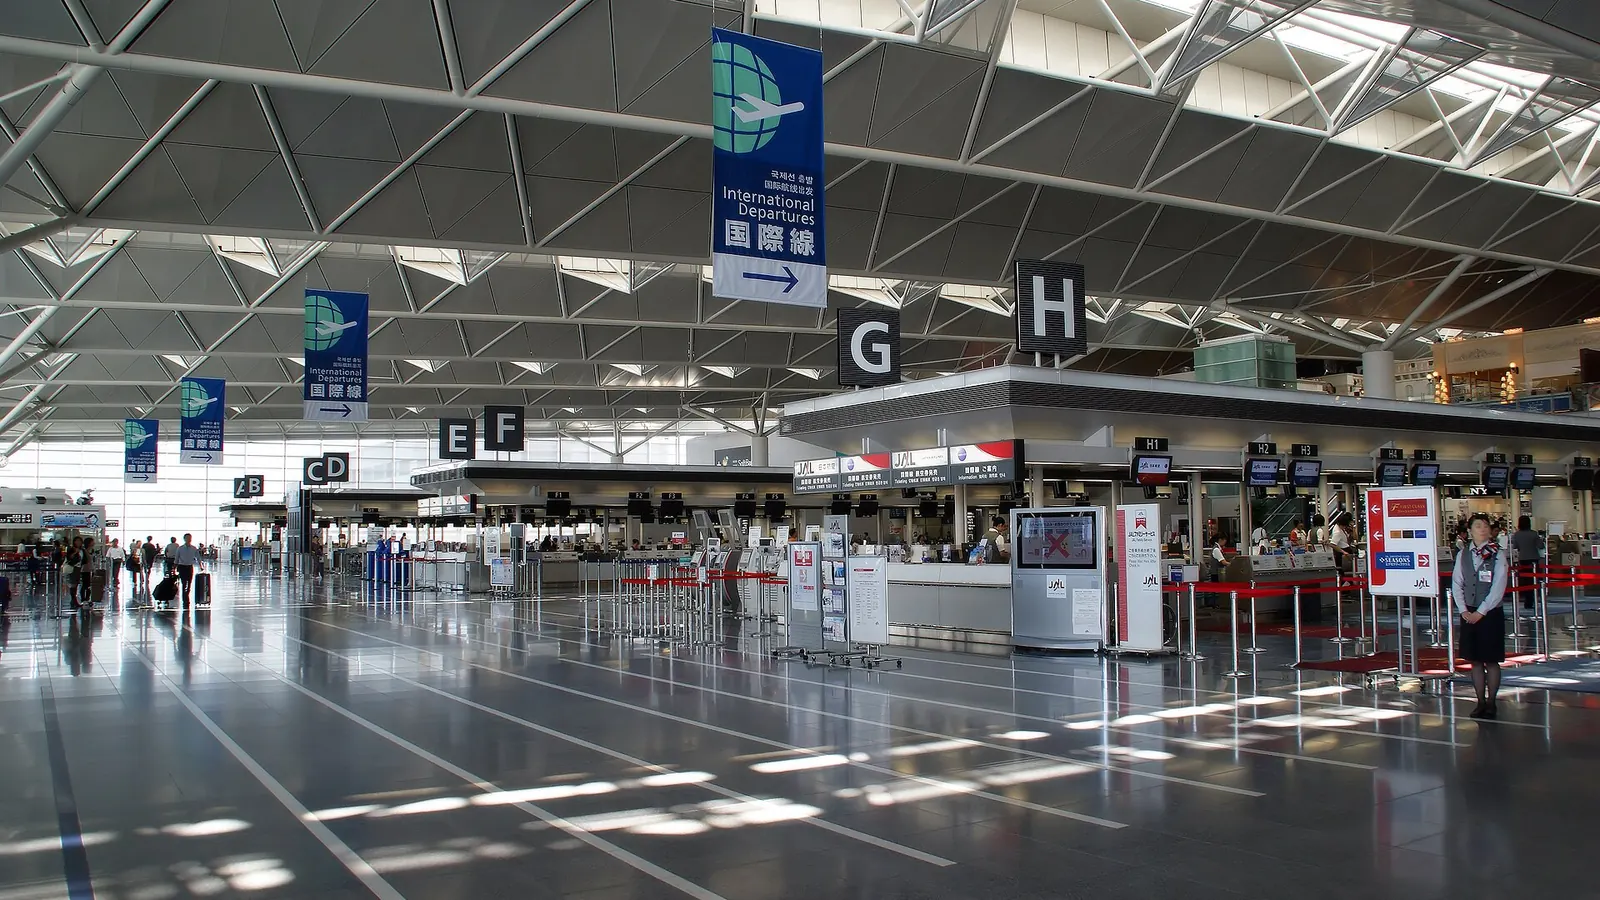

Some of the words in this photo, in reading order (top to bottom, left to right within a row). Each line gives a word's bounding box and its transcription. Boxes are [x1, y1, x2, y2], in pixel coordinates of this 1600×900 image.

[771, 170, 795, 182] 국제선
[798, 174, 813, 184] 출발
[723, 186, 814, 212] International
[739, 202, 815, 226] Departures
[725, 219, 815, 256] 国際線
[1033, 276, 1075, 338] H
[851, 321, 891, 373] G
[309, 367, 362, 376] International
[318, 375, 362, 383] Departures
[310, 384, 362, 398] 国際線
[497, 413, 516, 443] F
[449, 425, 468, 452] E
[1146, 438, 1158, 450] H1
[1258, 443, 1269, 454] H2
[1301, 445, 1311, 456] H3
[1388, 449, 1398, 459] H4
[1421, 451, 1431, 460] H5
[895, 450, 916, 468] JAL
[308, 462, 323, 481] C
[328, 457, 346, 477] D
[798, 460, 814, 476] JAL
[236, 481, 245, 495] A
[249, 478, 260, 493] B
[1469, 487, 1488, 495] NY
[1048, 578, 1065, 591] JAL
[1143, 574, 1159, 588] JAL
[1413, 577, 1430, 590] JAL
